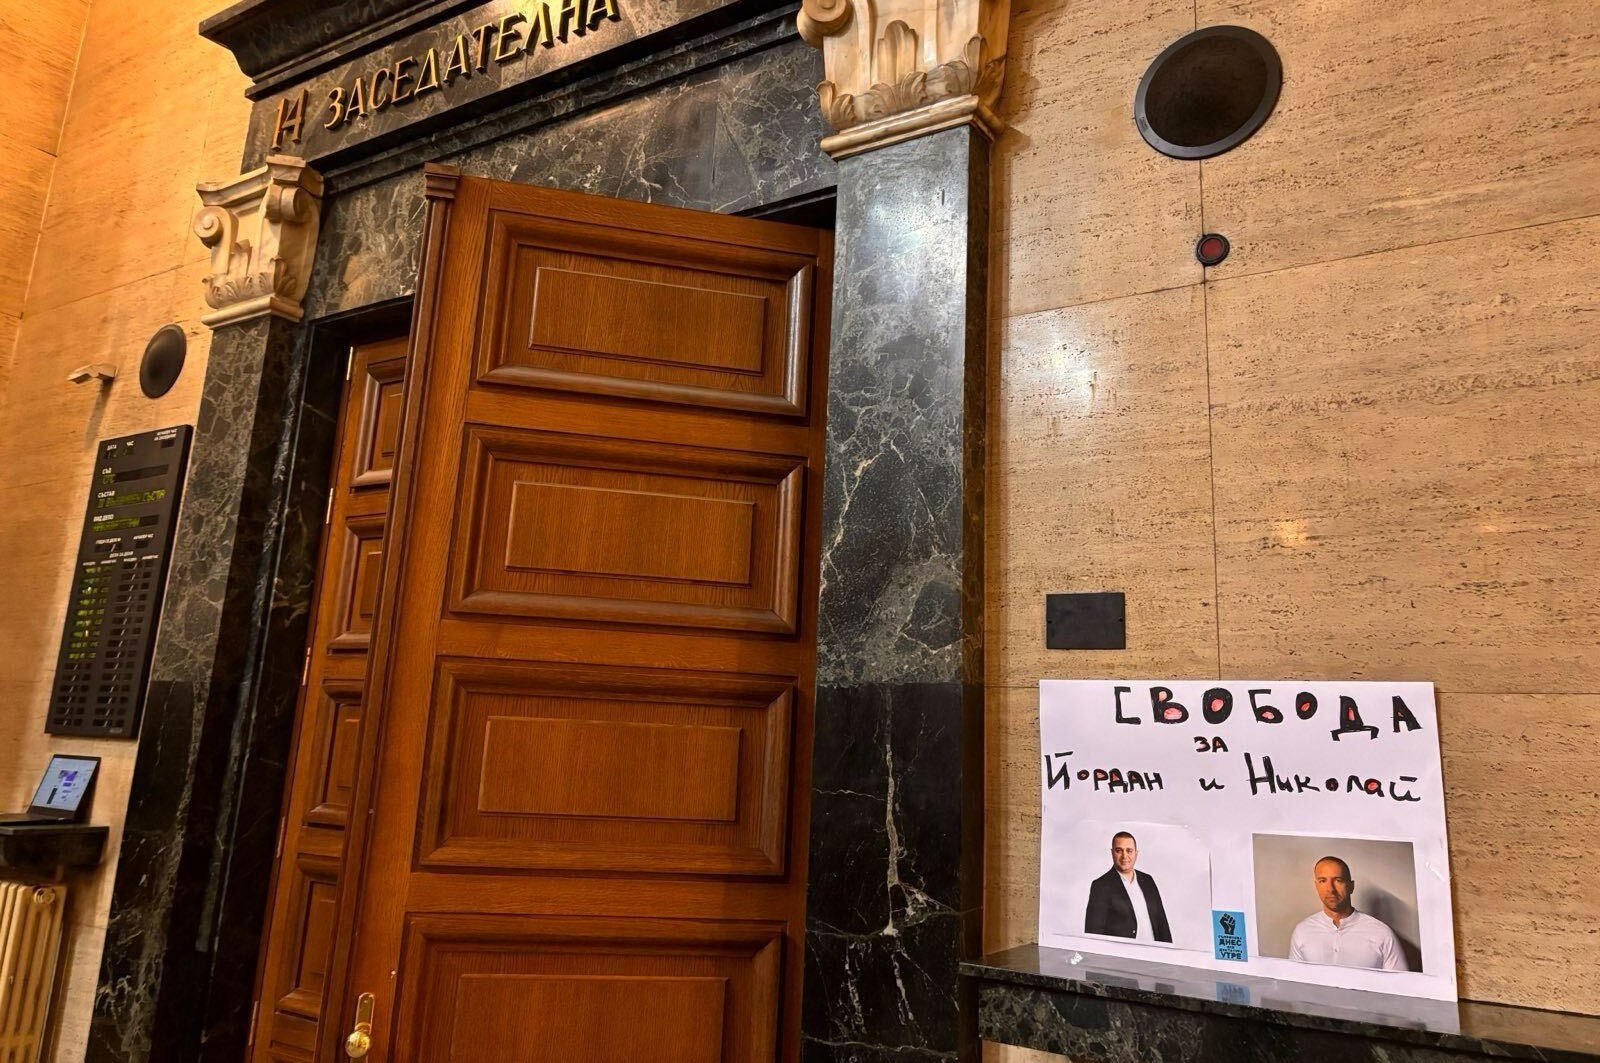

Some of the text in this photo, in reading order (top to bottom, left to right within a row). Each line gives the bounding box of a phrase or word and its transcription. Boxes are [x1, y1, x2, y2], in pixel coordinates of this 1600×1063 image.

[271, 88, 308, 151] 14
[1113, 686, 1422, 741] СВОБОДА
[1193, 736, 1229, 753] ЗА
